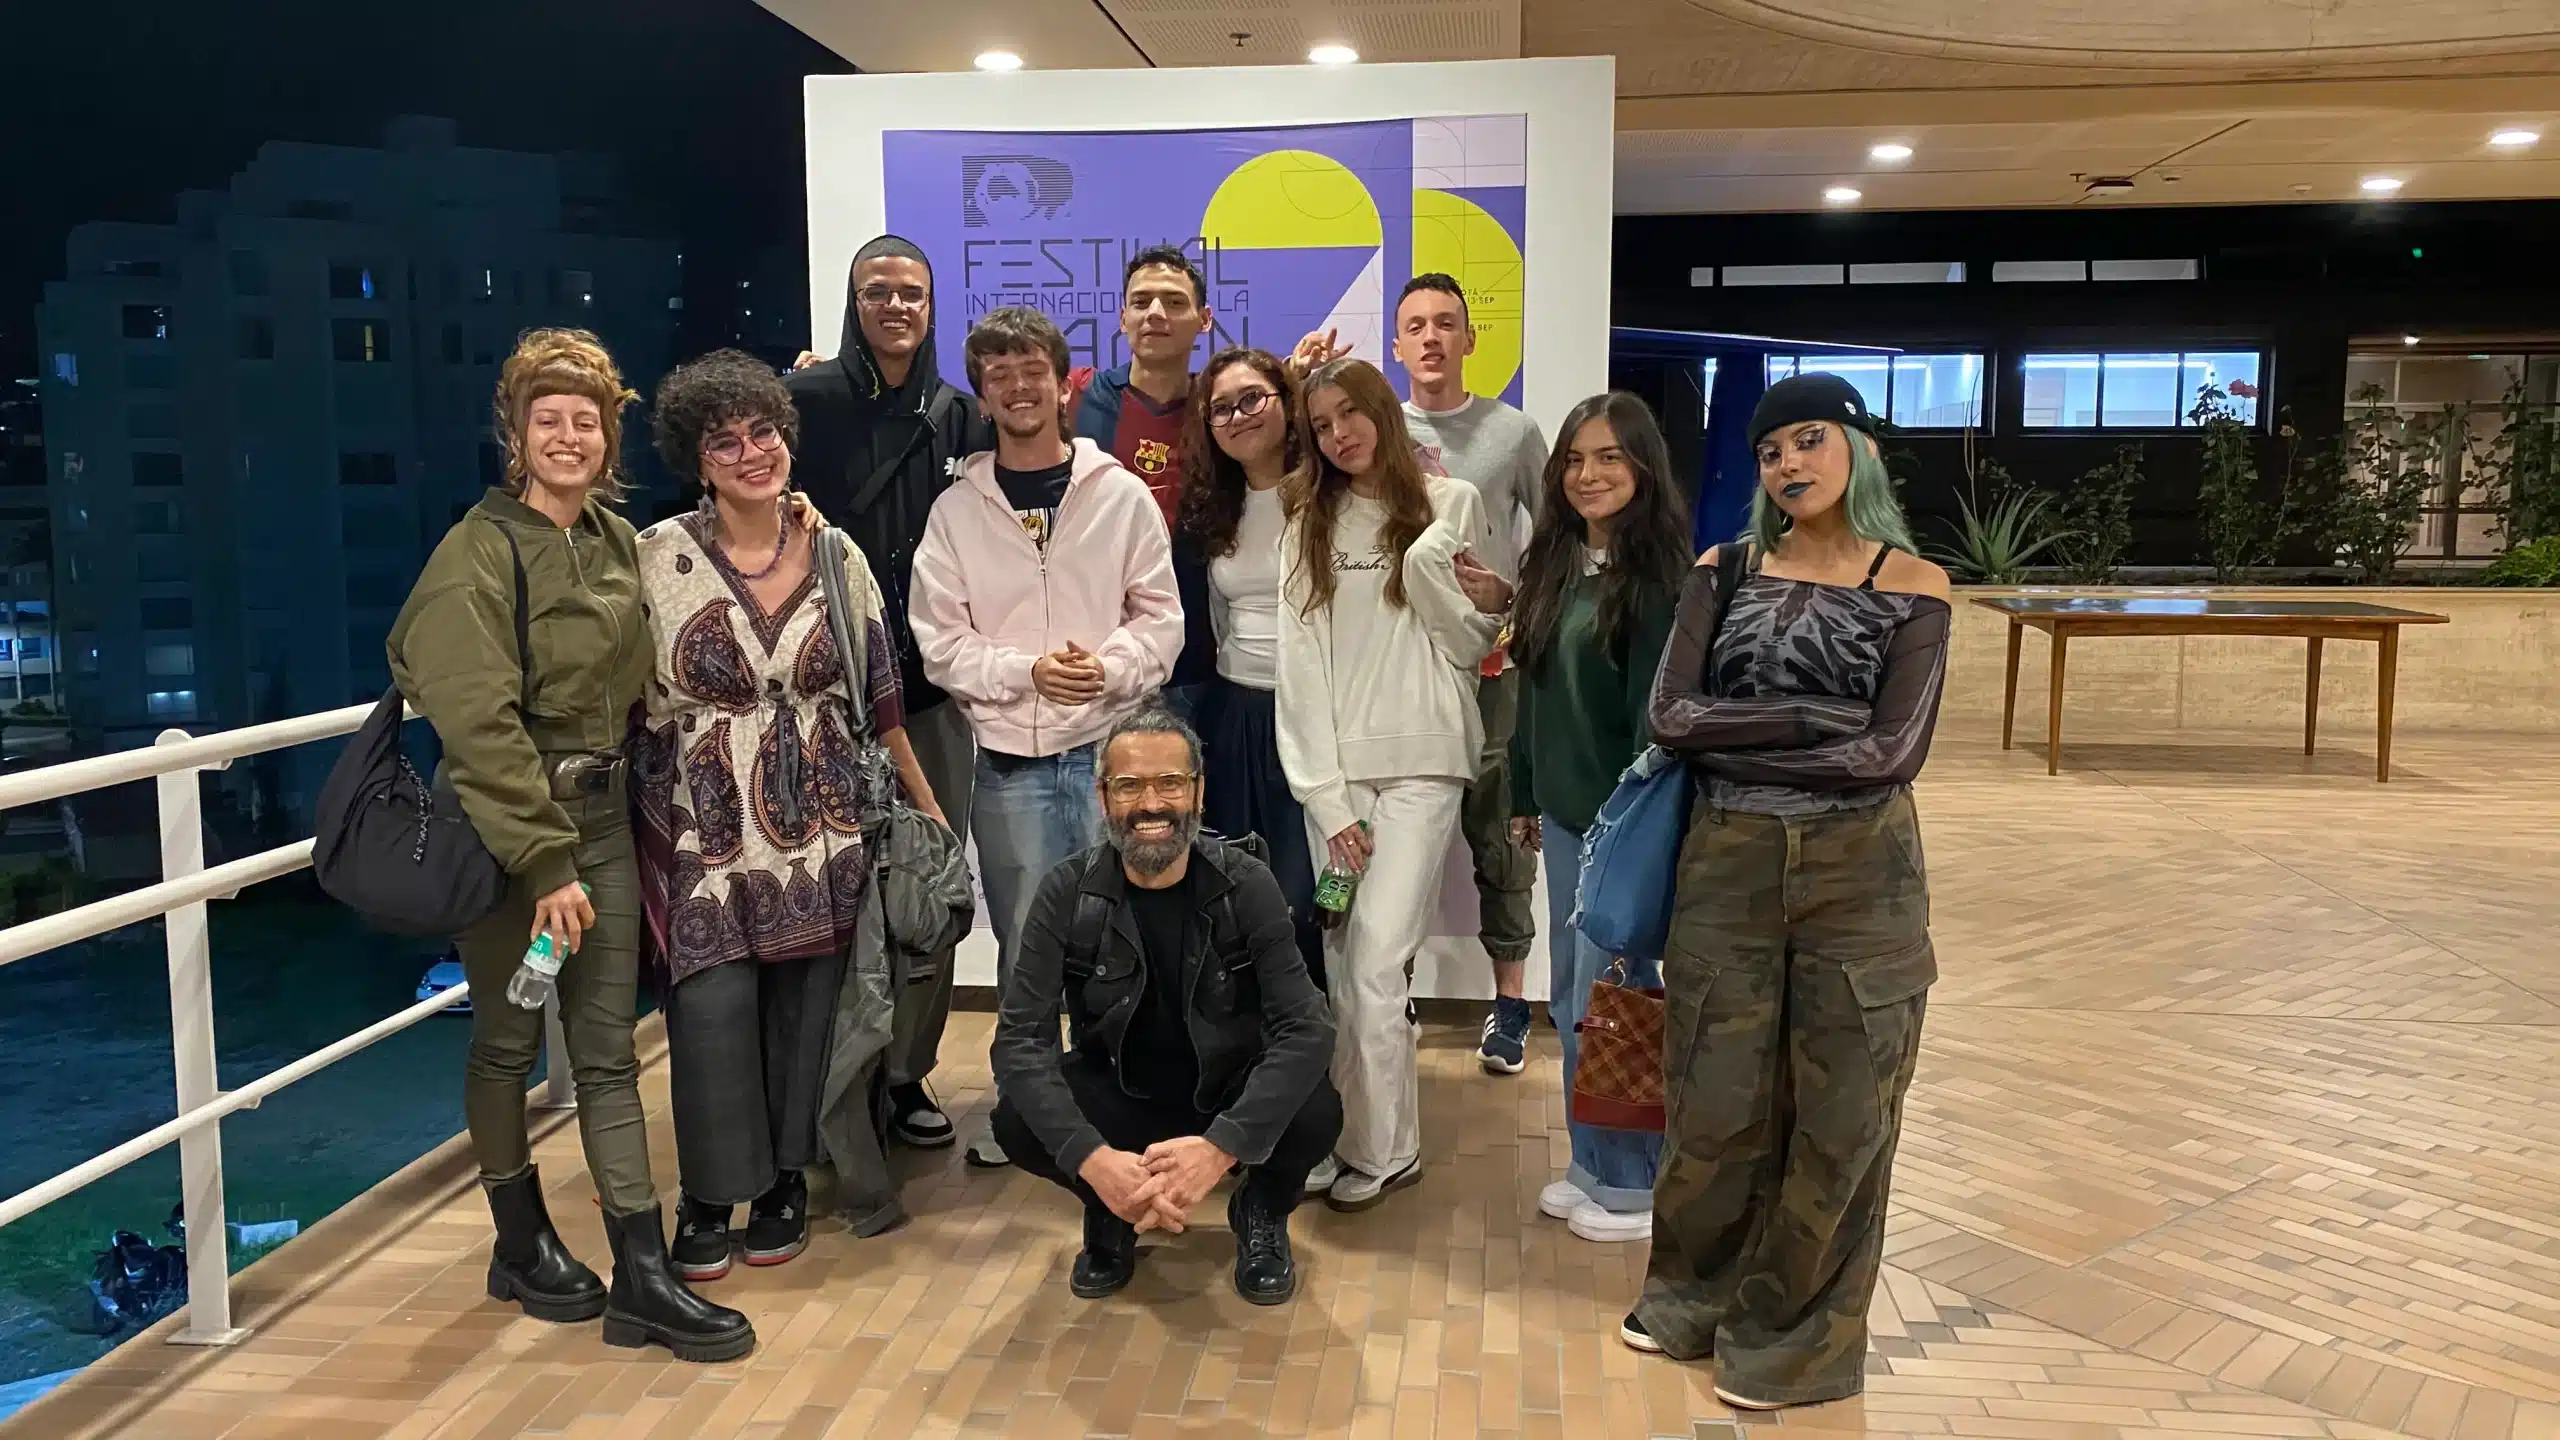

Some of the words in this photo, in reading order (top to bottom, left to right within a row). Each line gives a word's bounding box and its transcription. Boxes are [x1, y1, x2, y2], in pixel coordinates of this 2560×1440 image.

[964, 236, 1249, 288] FESTIAL
[965, 291, 1124, 315] INTERNACIO
[1217, 289, 1249, 312] LA
[1479, 296, 1495, 304] SEP
[1477, 323, 1493, 331] SEP
